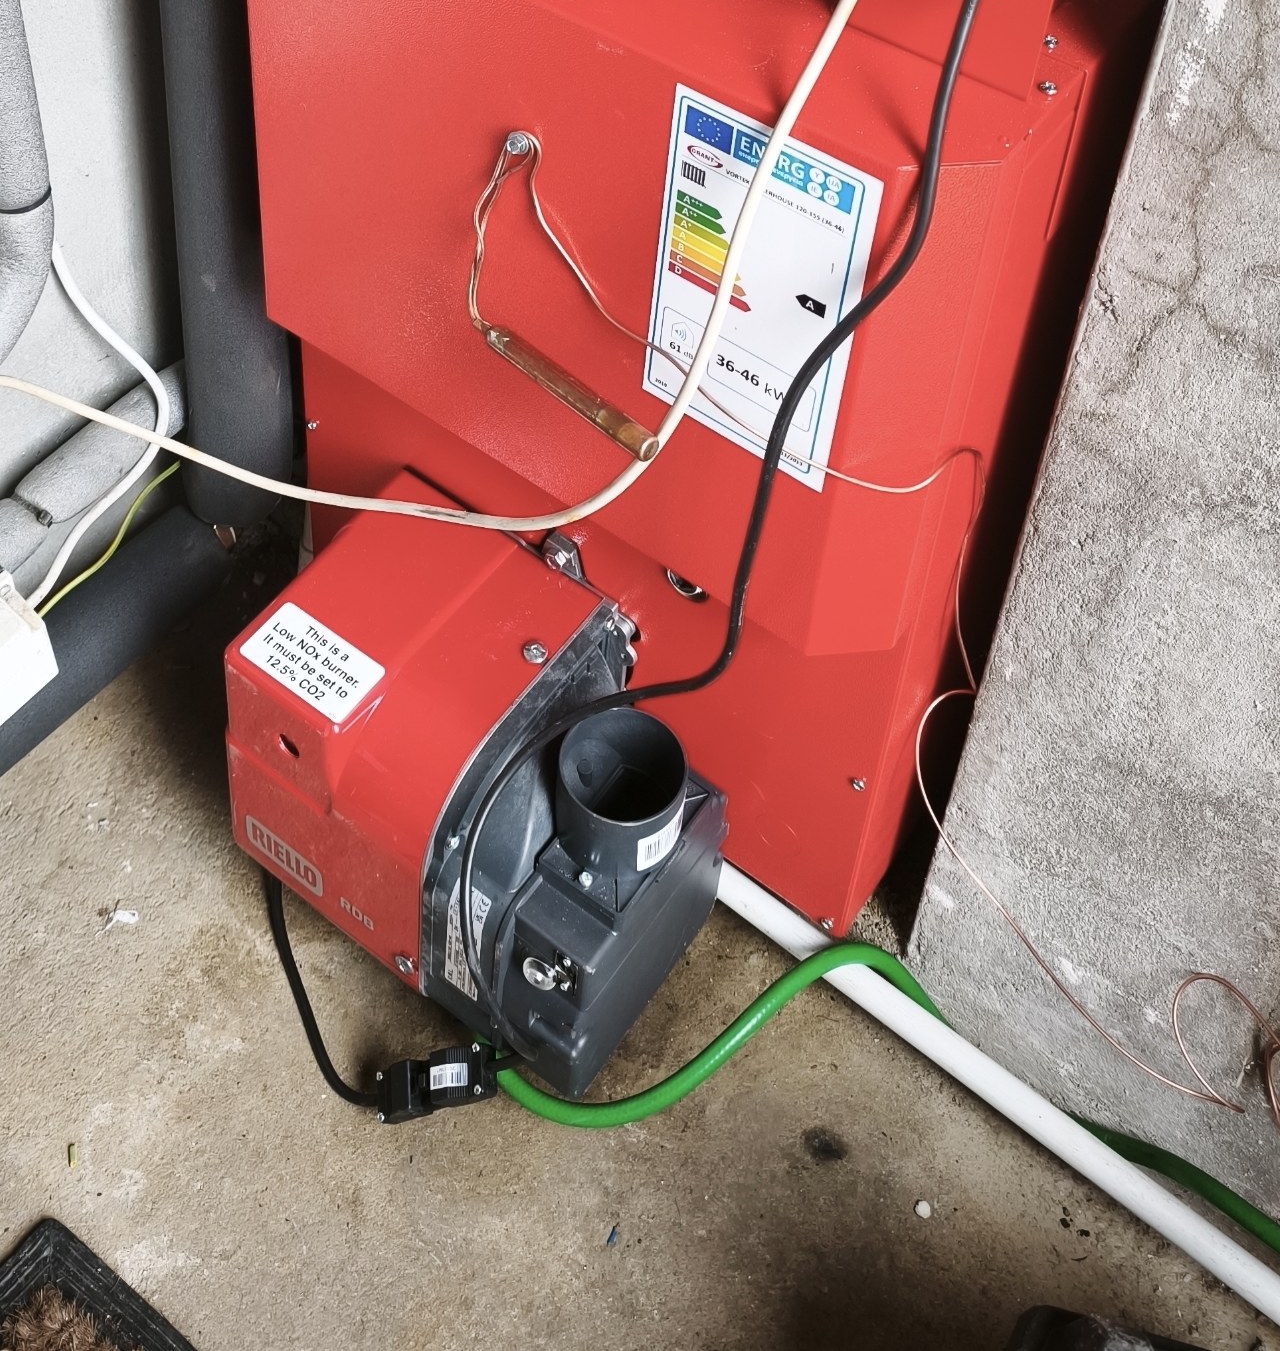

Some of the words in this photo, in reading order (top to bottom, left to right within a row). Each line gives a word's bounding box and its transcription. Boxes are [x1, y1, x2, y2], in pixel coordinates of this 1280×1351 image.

[690, 147, 716, 164] GRANT
[725, 168, 750, 185] VORTEX
[681, 207, 698, 218] A++
[680, 219, 692, 229] A+
[678, 231, 686, 240] A
[677, 242, 685, 252] B
[676, 254, 683, 264] C
[674, 265, 682, 275] D
[805, 300, 815, 312] A
[669, 341, 682, 354] 61
[715, 353, 761, 388] 36-46
[764, 382, 786, 402] kW
[305, 625, 329, 647] This
[328, 643, 340, 656] is
[340, 653, 350, 663] a
[272, 621, 297, 642] Low
[296, 638, 322, 661] NOx
[320, 656, 360, 689] burner.
[262, 633, 275, 645] It
[272, 641, 302, 665] must
[300, 660, 316, 676] be
[316, 673, 337, 691] set
[335, 685, 349, 699] to
[266, 654, 297, 682] 12.5%
[298, 678, 326, 701] CO2
[251, 821, 317, 889] RIELLO
